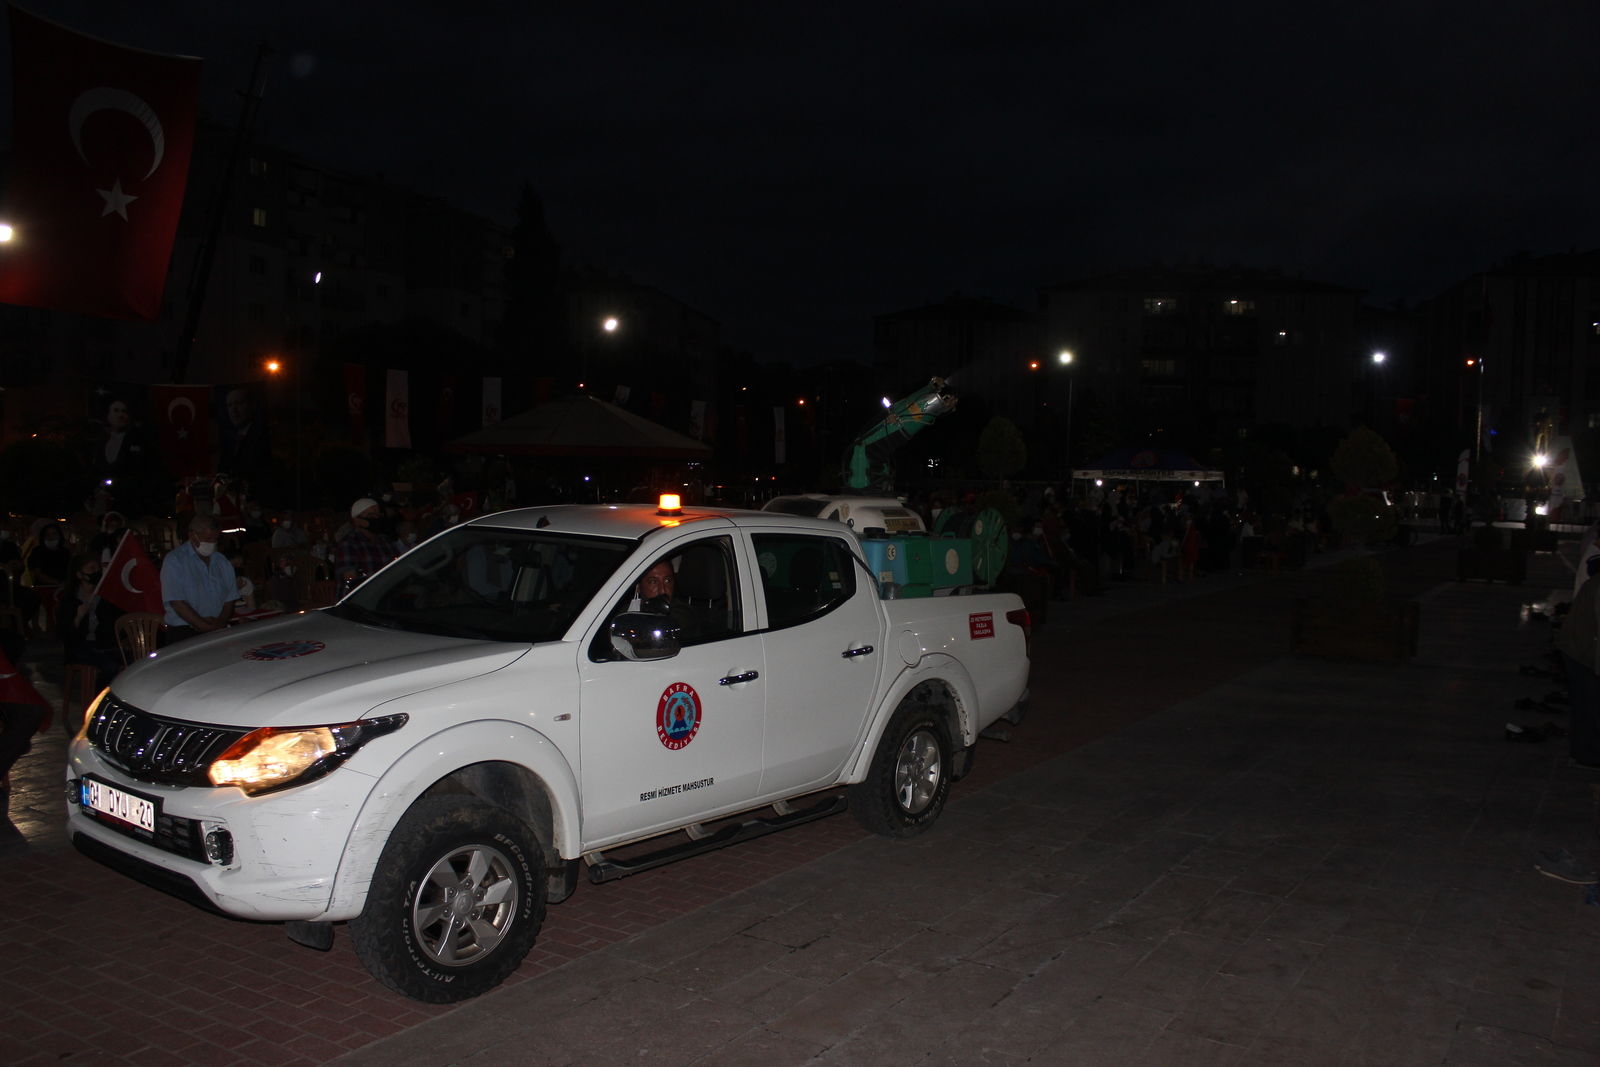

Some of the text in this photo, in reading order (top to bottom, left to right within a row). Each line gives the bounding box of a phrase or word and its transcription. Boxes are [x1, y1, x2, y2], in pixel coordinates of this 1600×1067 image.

[640, 777, 714, 801] RESMİ HİZMETE MAHSUSTUR
